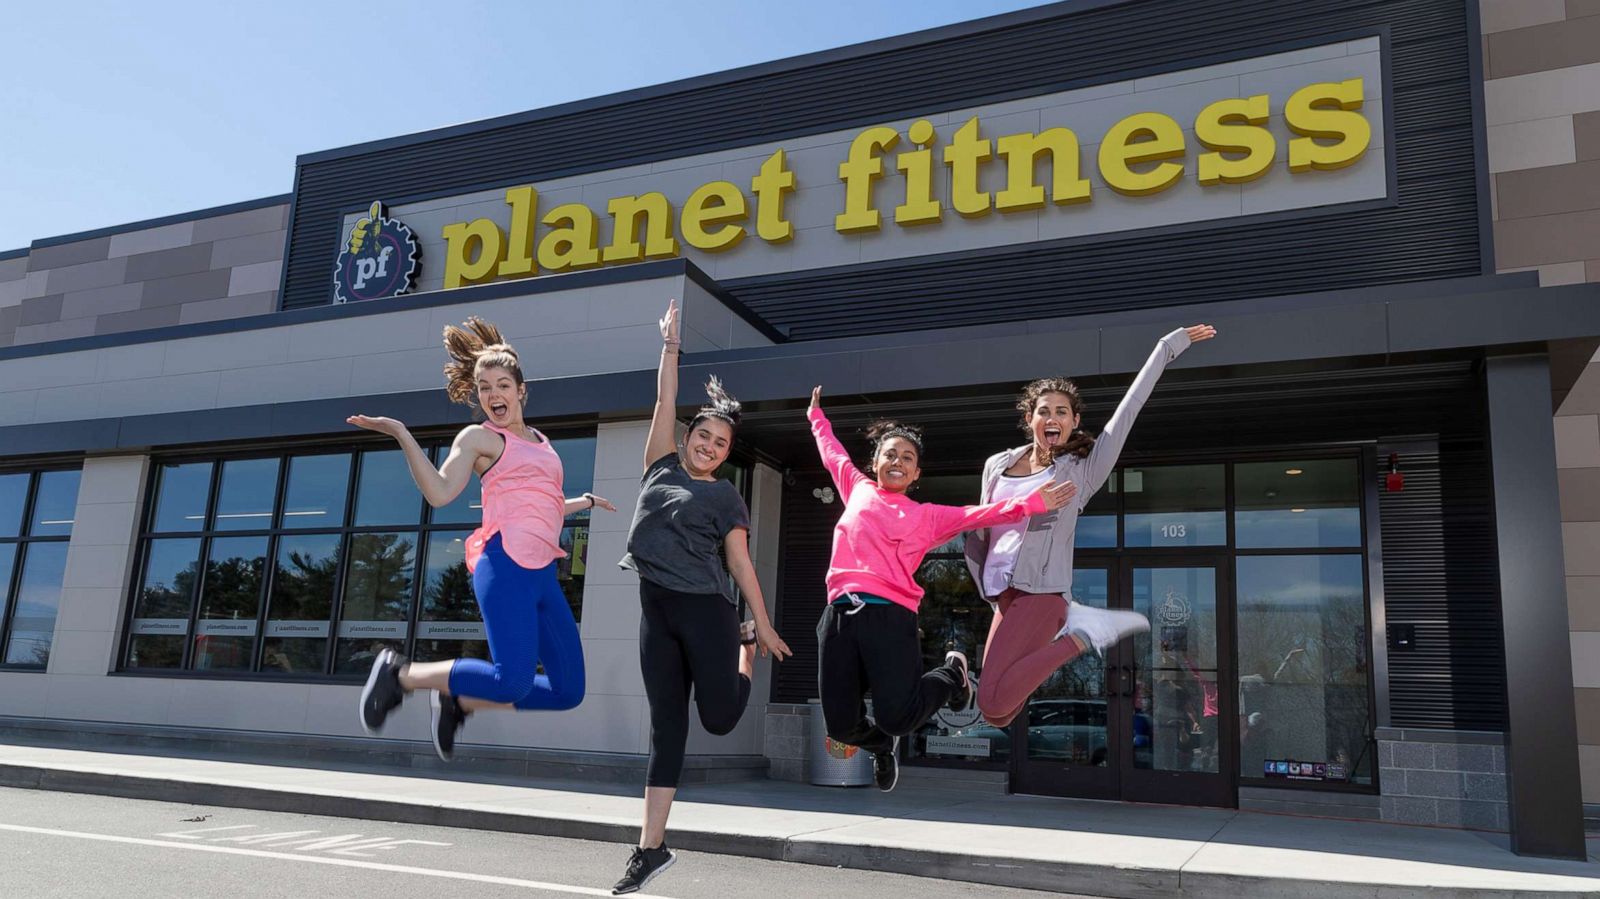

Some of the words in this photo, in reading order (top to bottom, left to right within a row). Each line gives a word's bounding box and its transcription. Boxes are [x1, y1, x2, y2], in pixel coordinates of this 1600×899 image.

[442, 149, 796, 290] planet
[835, 78, 1372, 233] fitness
[353, 245, 394, 290] pf
[1162, 525, 1185, 537] 103
[928, 740, 988, 750] planetfitness.com
